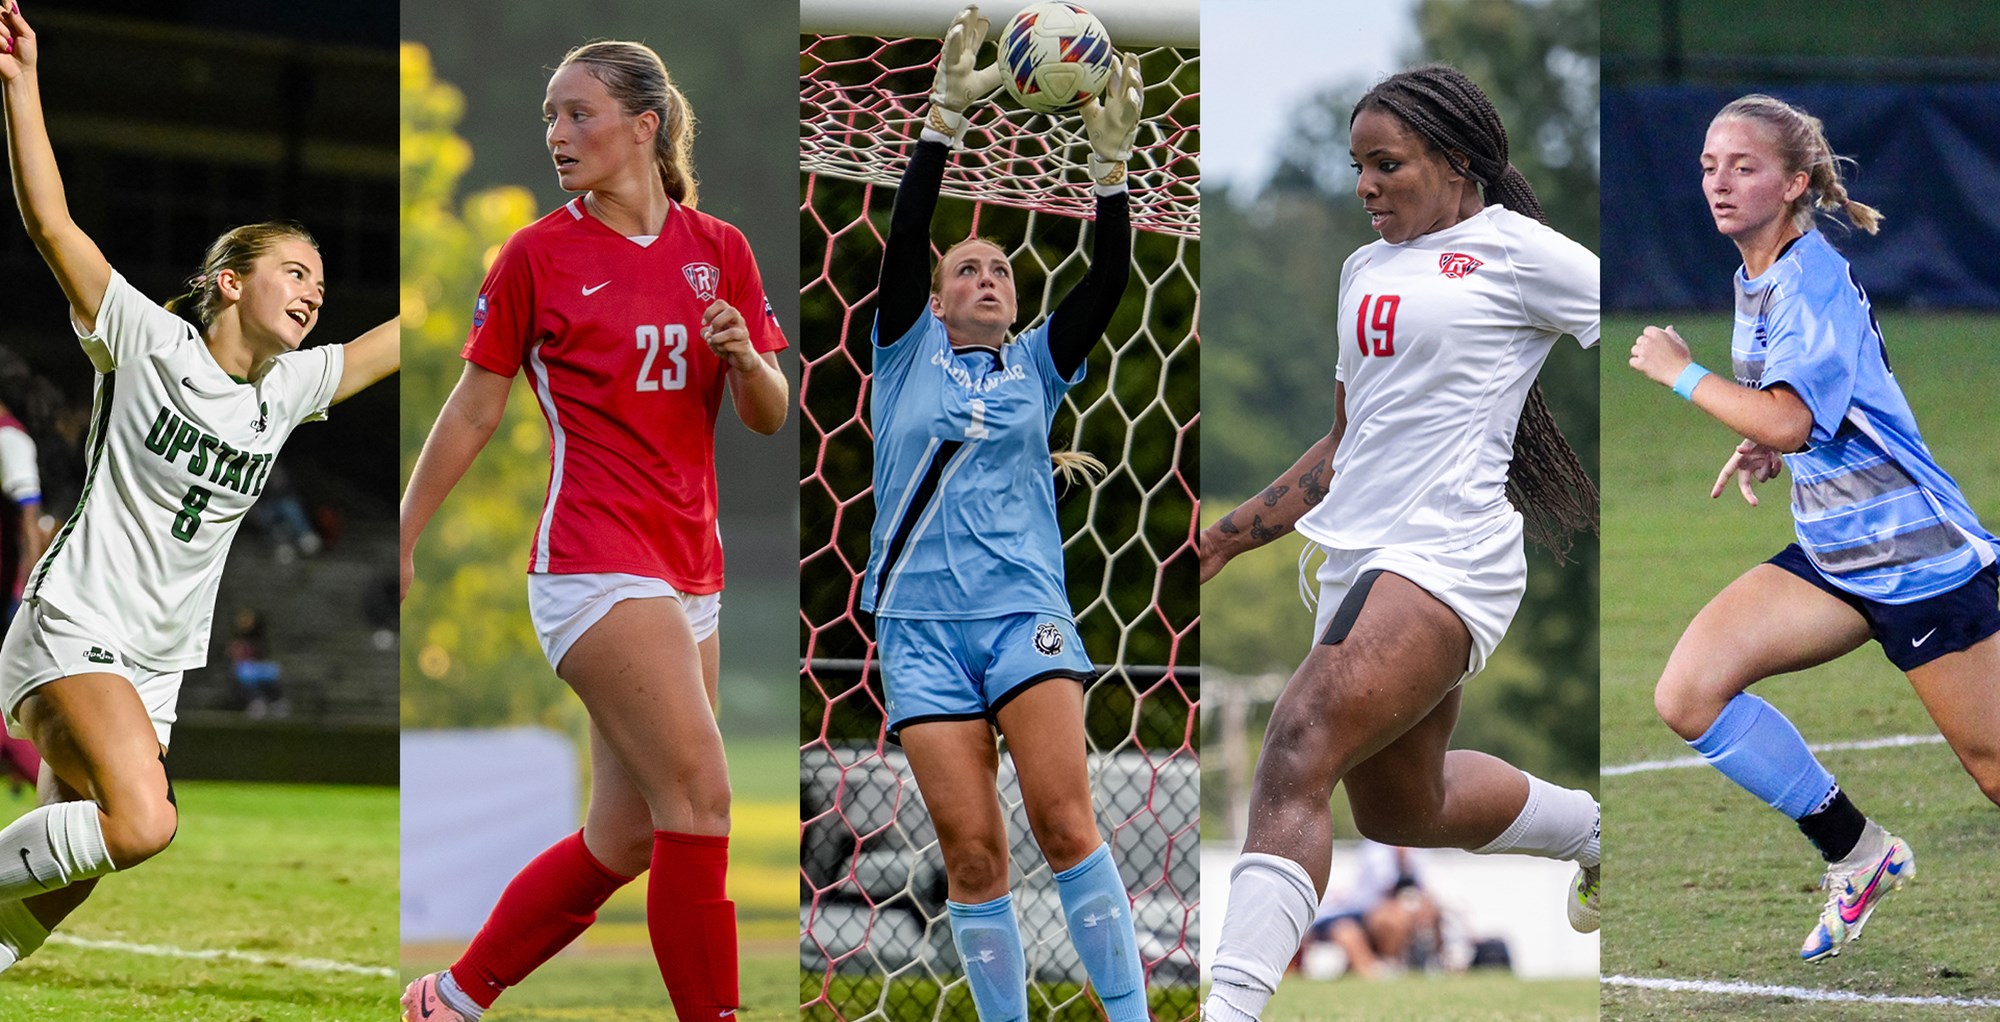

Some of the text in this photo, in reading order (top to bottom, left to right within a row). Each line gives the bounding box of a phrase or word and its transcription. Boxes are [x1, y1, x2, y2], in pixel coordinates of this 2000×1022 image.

[1357, 294, 1400, 357] 19
[635, 324, 687, 391] 23
[964, 398, 989, 439] 1
[145, 406, 272, 496] UPSTATE
[171, 485, 212, 543] 8
